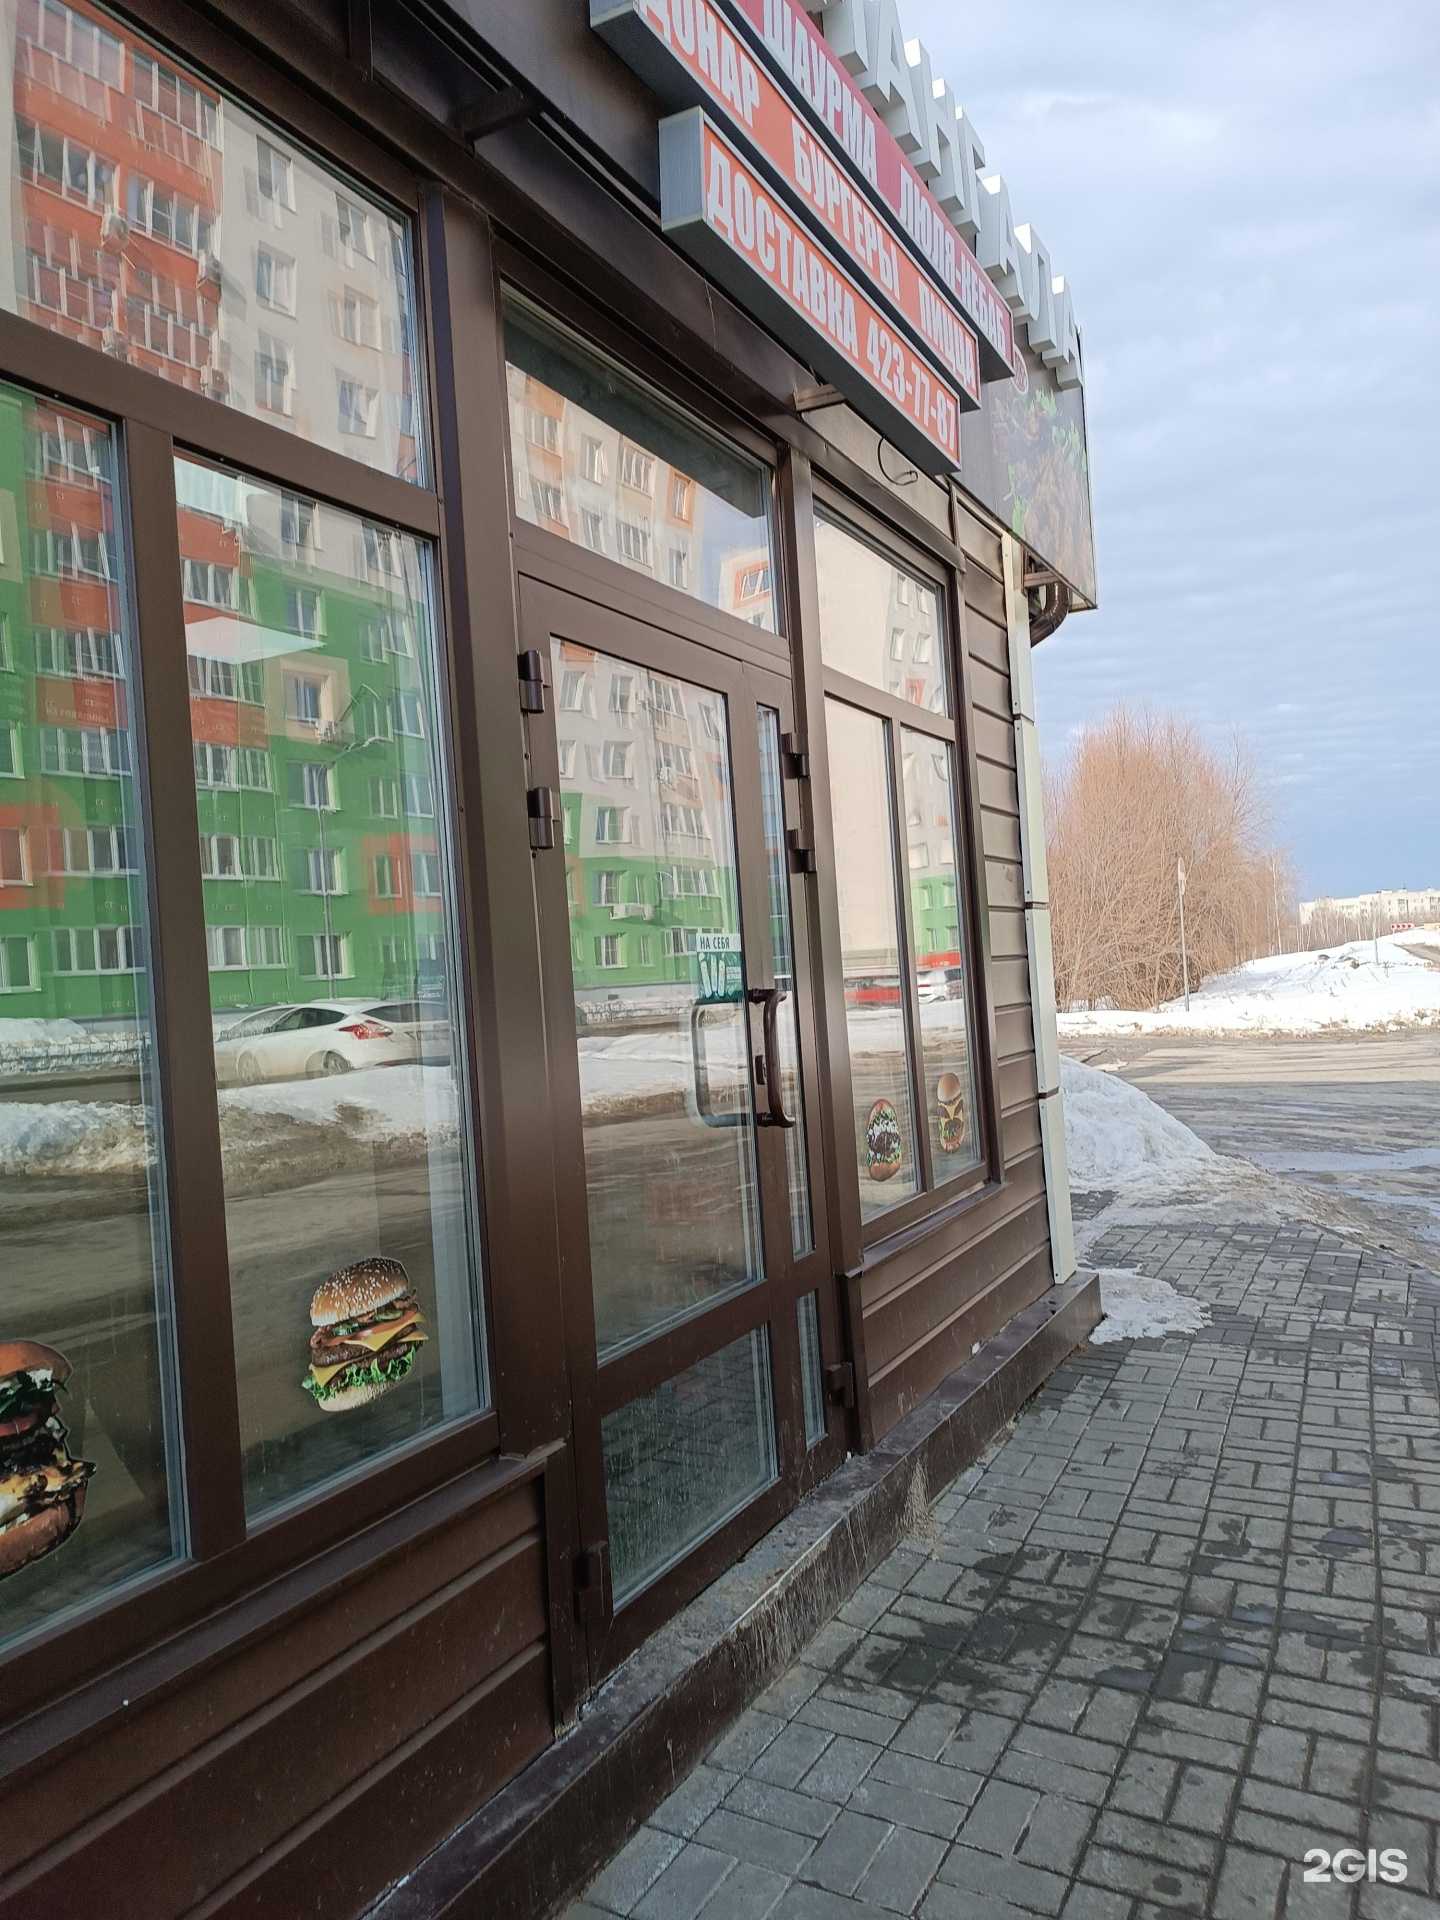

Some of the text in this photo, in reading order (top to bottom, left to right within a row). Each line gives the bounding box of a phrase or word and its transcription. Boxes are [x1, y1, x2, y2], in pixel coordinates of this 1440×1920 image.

[707, 141, 956, 451] ДОСТАВКА 423-77-87
[763, 0, 1006, 354] ШАУРМА ЛЮЛЯ-КЕБАБ
[791, 118, 900, 300] БУРГЕРЫ
[918, 278, 975, 388] ПИЦЦА
[806, 0, 1081, 388] АНГАЛА
[700, 937, 730, 949] НА СЕБЯ
